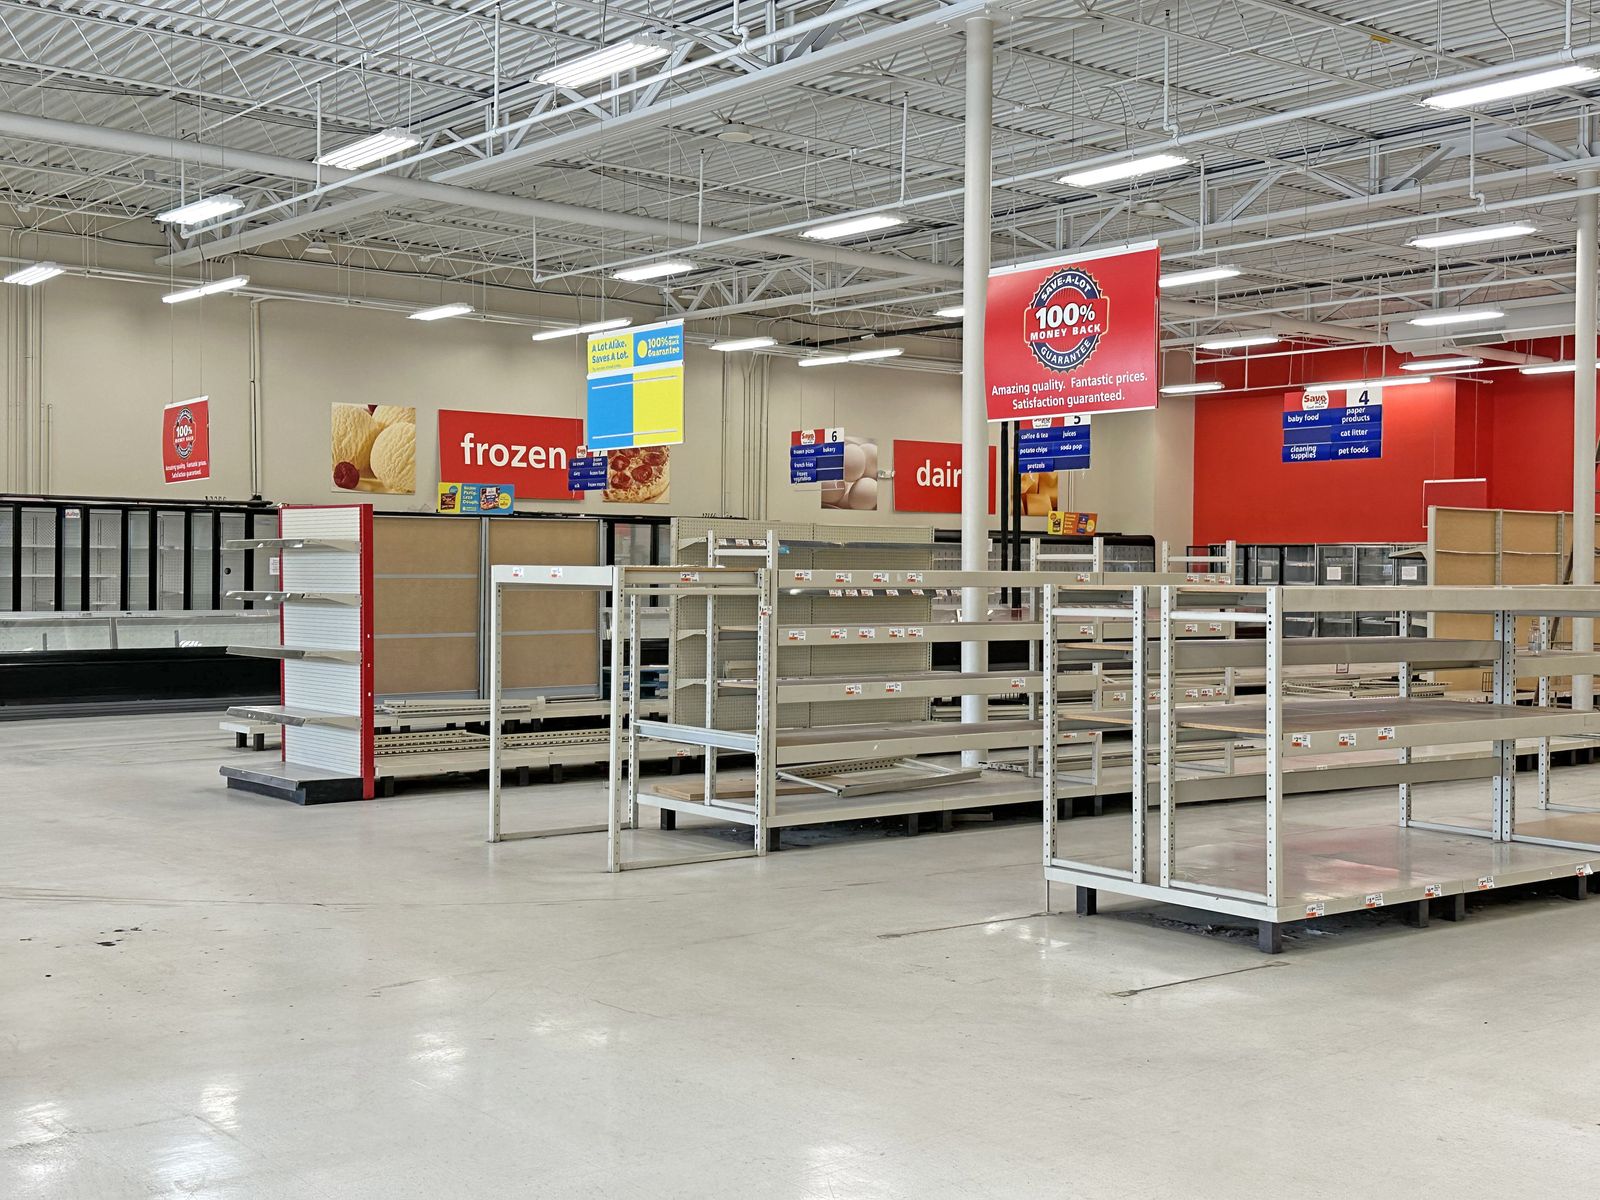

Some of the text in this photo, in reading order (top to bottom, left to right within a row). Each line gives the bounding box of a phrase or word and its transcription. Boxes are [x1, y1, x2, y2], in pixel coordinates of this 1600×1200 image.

[1035, 303, 1096, 329] 100%
[1030, 323, 1101, 341] MONEY BACK
[647, 336, 669, 349] 100%
[647, 345, 680, 357] Guarantee
[1040, 340, 1091, 364] GUARANTEE
[592, 354, 610, 363] Saves
[991, 372, 1148, 396] Amazing quality. Fantastic prices.
[1012, 389, 1125, 410] Satisfaction guaranteed.
[1303, 395, 1327, 403] Save
[1358, 390, 1370, 405] 4
[1346, 407, 1366, 415] paper
[1287, 413, 1320, 424] baby food
[1341, 414, 1370, 424] products
[831, 430, 837, 442] 6
[460, 432, 567, 470] frozen
[1290, 445, 1317, 453] cleaning
[1338, 446, 1369, 456] pet foods
[1290, 452, 1317, 460] supplies
[916, 459, 962, 488] dair
